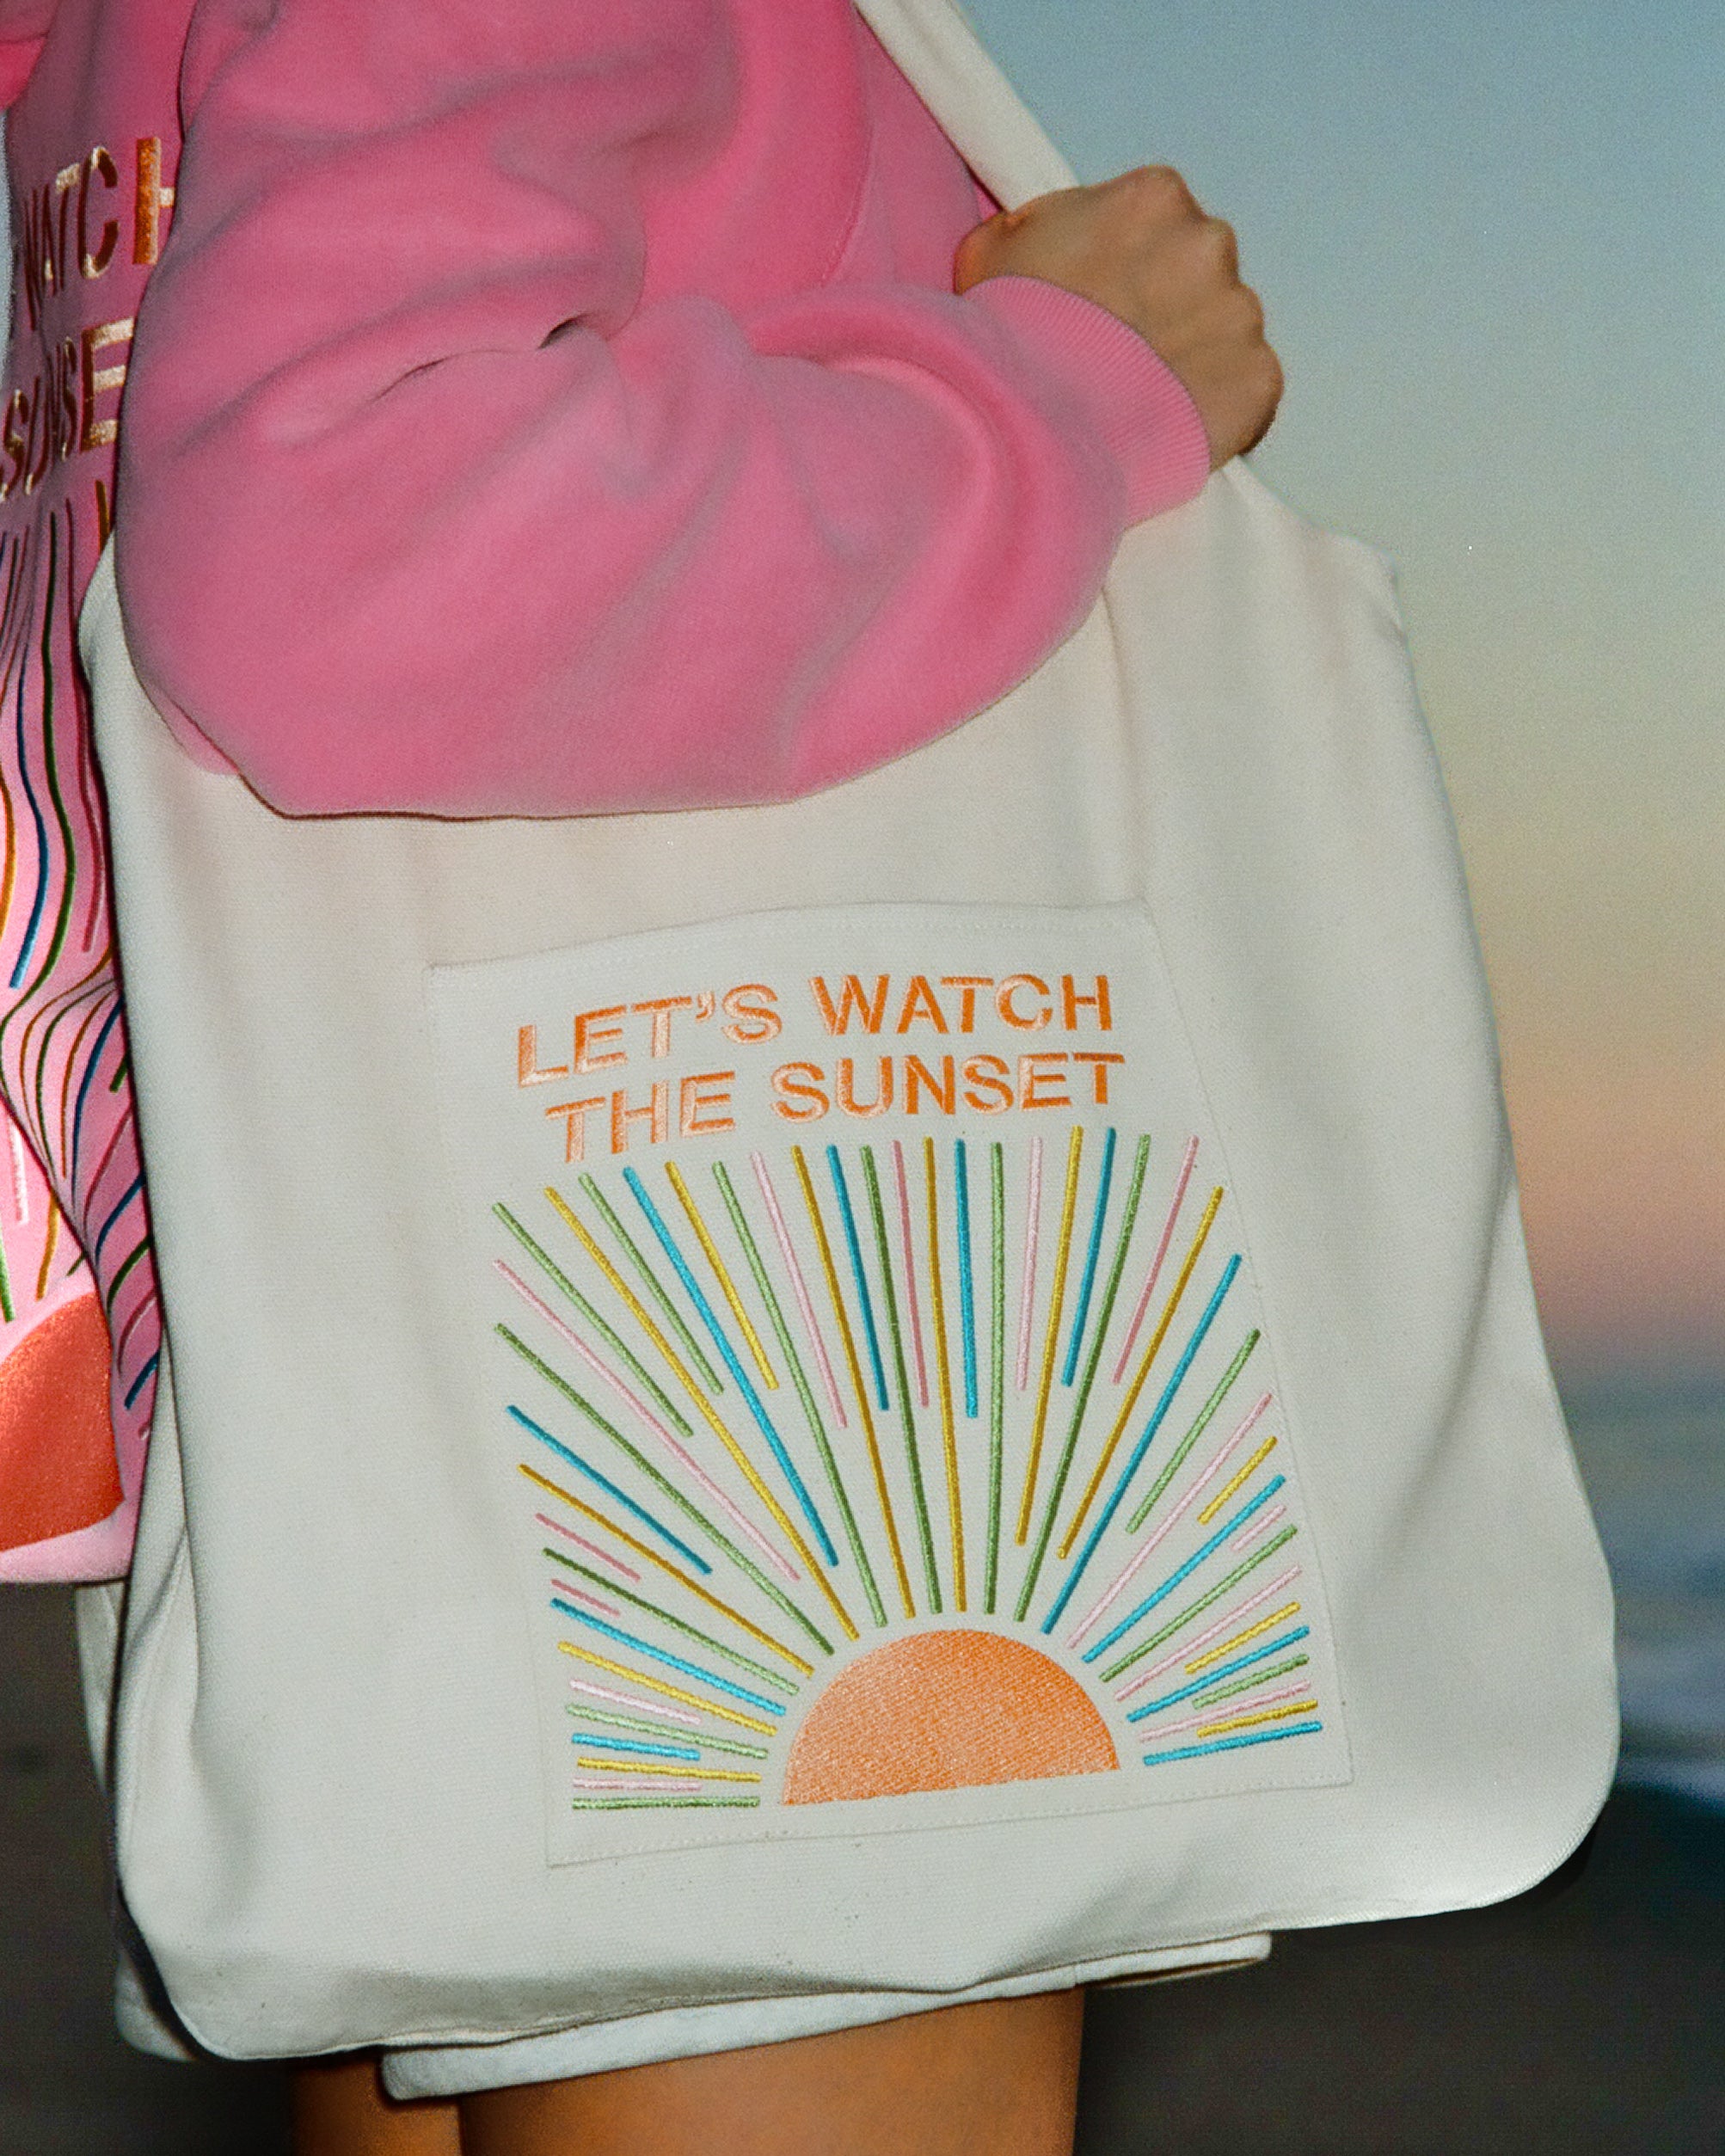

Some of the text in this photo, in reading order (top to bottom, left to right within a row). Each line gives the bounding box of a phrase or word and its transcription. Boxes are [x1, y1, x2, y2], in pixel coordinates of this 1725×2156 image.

[518, 974, 1113, 1089] LET'S WATCH
[544, 1051, 1125, 1164] THE SUNSET
